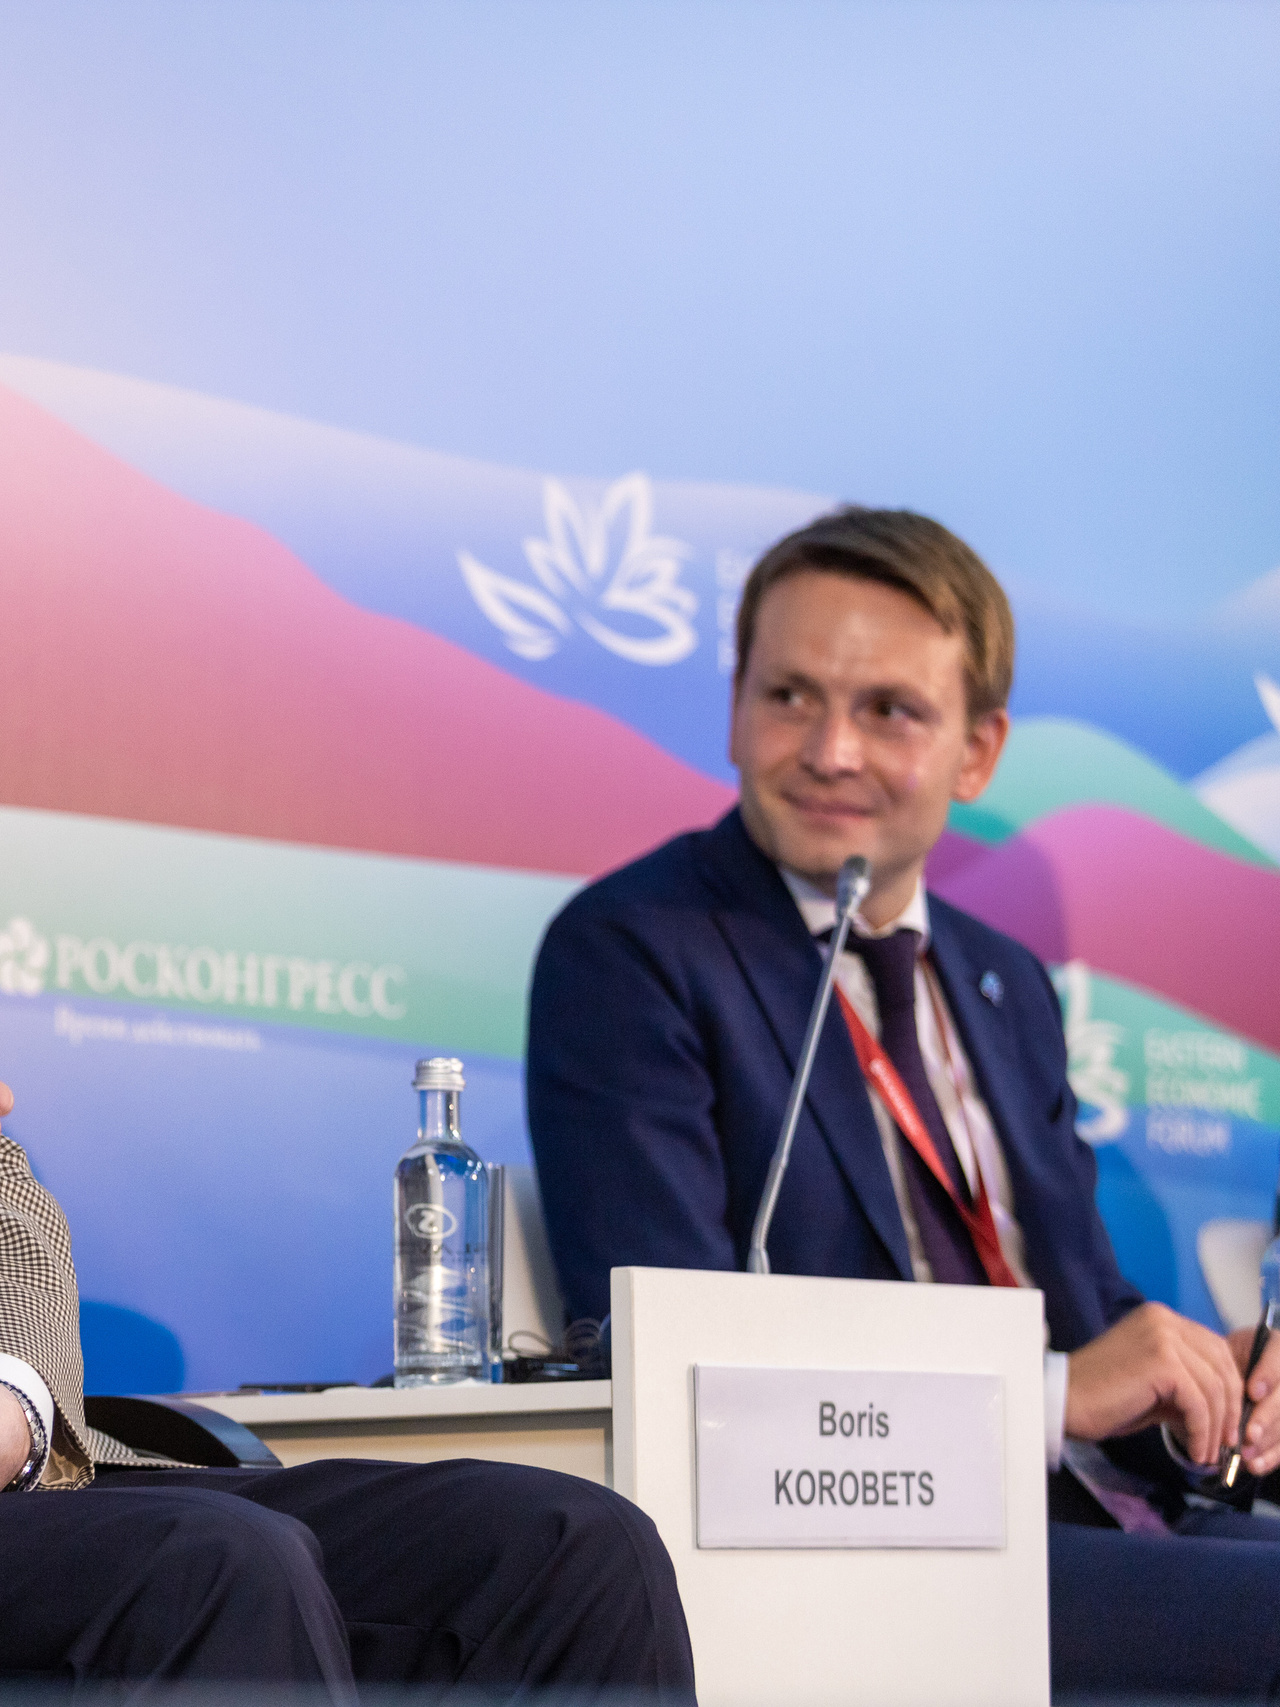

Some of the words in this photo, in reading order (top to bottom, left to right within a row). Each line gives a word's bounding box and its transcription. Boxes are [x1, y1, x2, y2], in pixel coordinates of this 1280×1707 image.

[54, 934, 408, 1021] РОСКОНГРЕСС
[818, 1400, 891, 1438] Boris
[773, 1468, 936, 1507] KOROBETS
